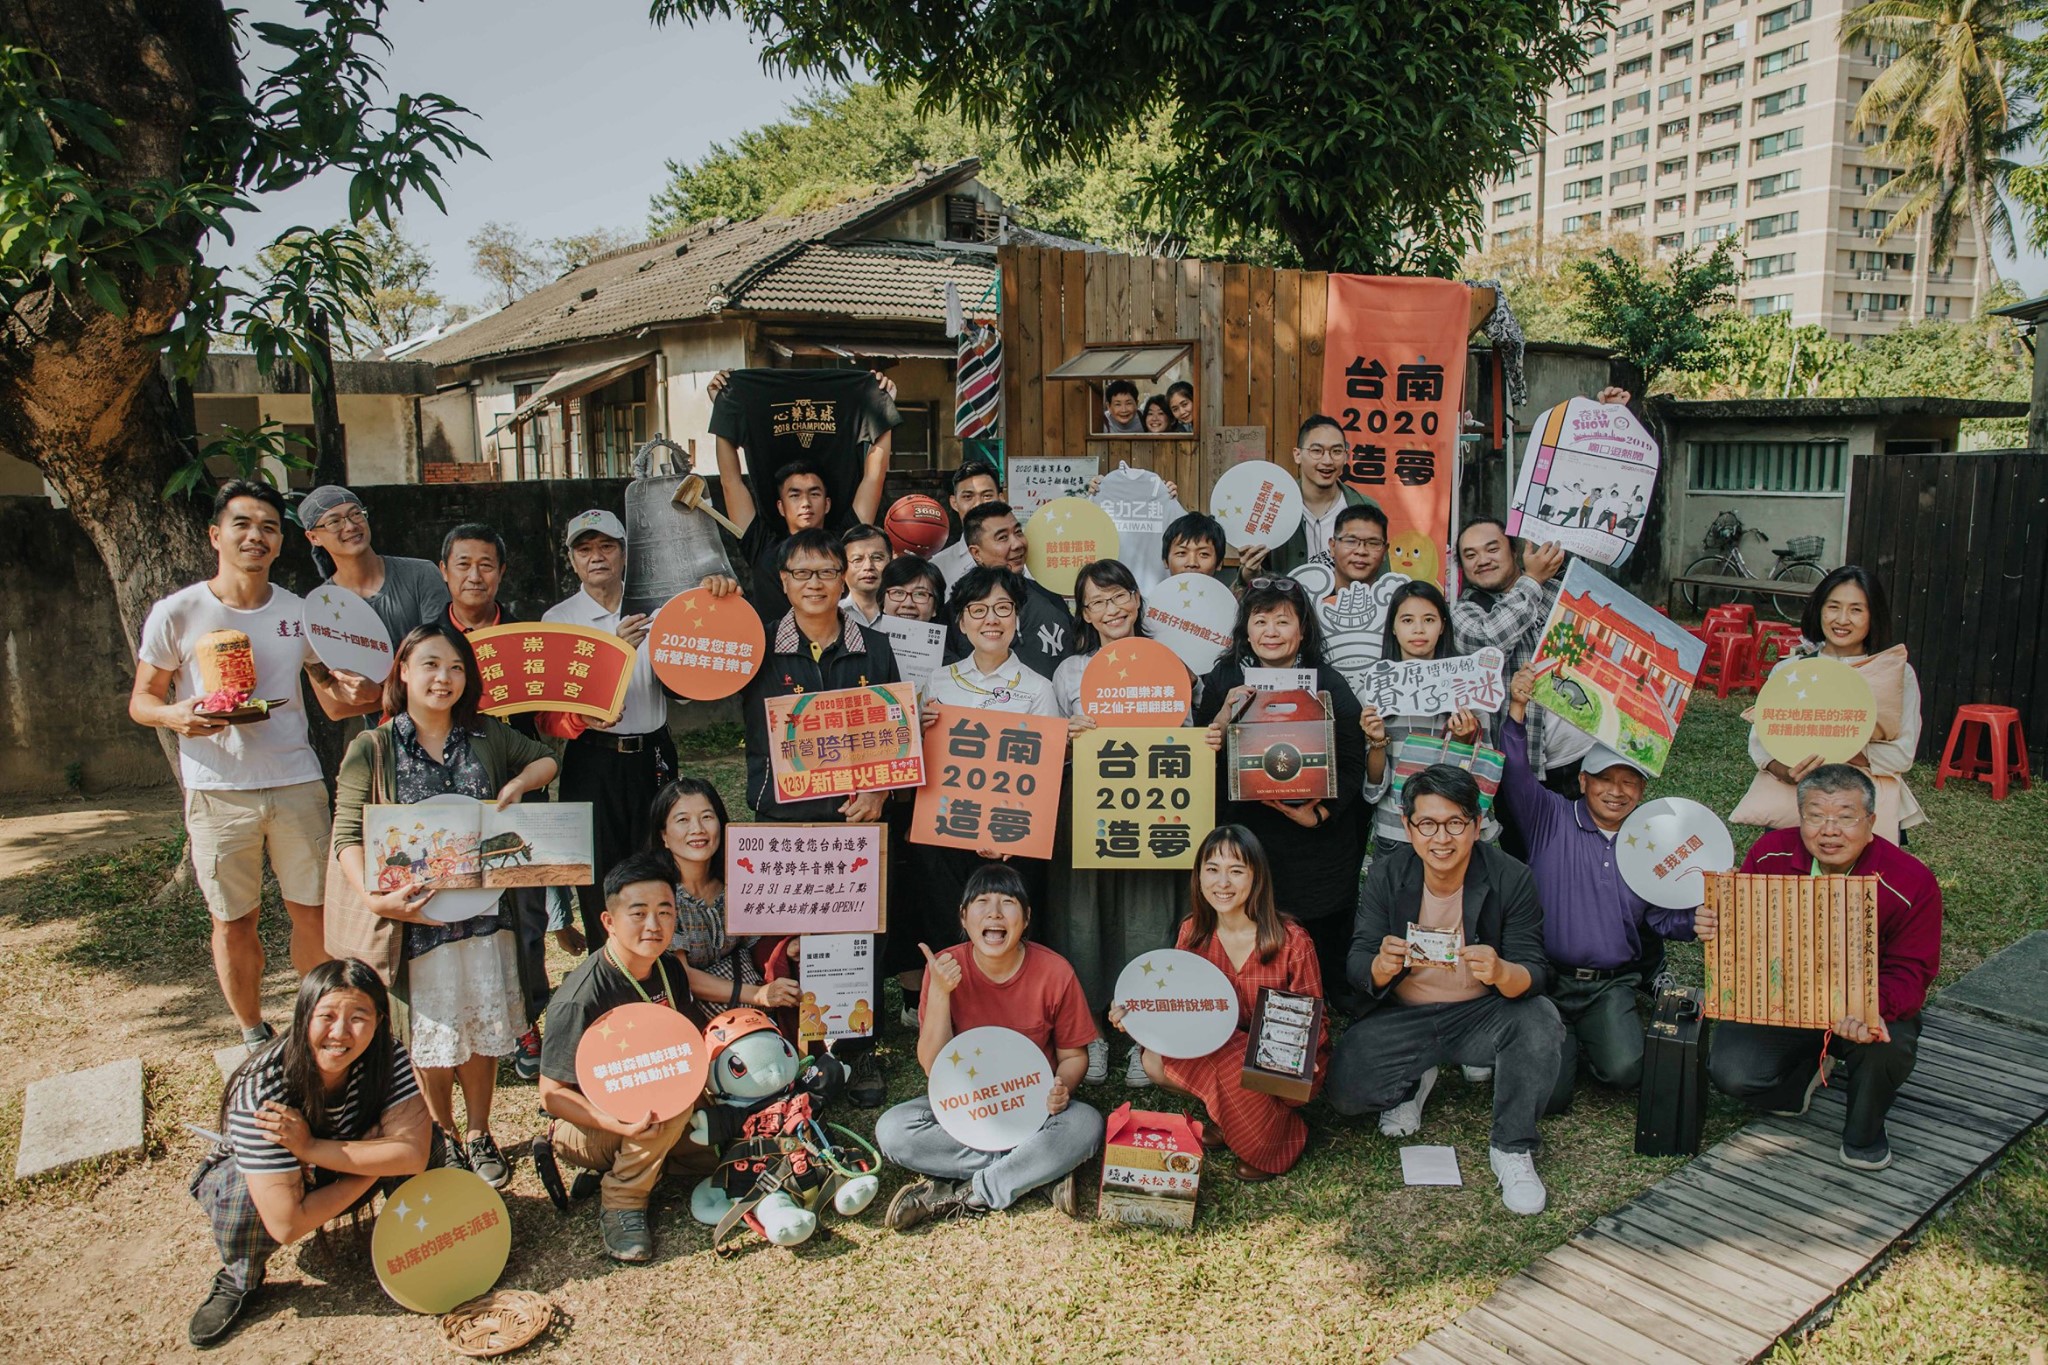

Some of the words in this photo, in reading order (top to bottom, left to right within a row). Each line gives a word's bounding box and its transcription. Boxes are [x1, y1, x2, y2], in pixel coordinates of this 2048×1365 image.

[1345, 356, 1444, 401] 台南
[773, 422, 790, 433] 2018
[792, 421, 836, 432] CHAMPIONS
[1342, 408, 1439, 436] 2020
[1572, 419, 1610, 430] SHOW
[1626, 436, 1653, 451] 2019
[1342, 444, 1435, 486] 造夢
[914, 507, 941, 517] 3600
[1259, 490, 1286, 534] 演出計畫
[1118, 522, 1153, 531] TAIWAN
[1046, 541, 1096, 554] 敲鐘擂鼓
[1046, 555, 1096, 569] 跨年祈福
[311, 623, 389, 653] 府城二十四節氣巷
[661, 633, 753, 657] 2020愛您愛您
[475, 643, 509, 702] 集福宮
[523, 637, 545, 696] 崇福宮
[563, 639, 596, 699] 聚福宮
[654, 648, 754, 675] 新營跨年音樂會
[815, 694, 872, 711] 2020愛您愛您
[1096, 686, 1175, 699] 2020國樂演奏
[803, 705, 887, 732] 台南造夢
[1762, 708, 1867, 722] 與在地居民的深夜
[948, 718, 1043, 766] 台南
[1767, 723, 1859, 737] 廣播劇集體創作
[781, 726, 911, 766] 新營跨年音樂會
[1097, 737, 1191, 779] 台南
[811, 763, 919, 793] 新營火車站
[942, 765, 1036, 796] 2020
[1096, 787, 1191, 810] 2020
[934, 798, 1033, 843] 造夢
[738, 838, 764, 851] 2020
[768, 837, 868, 853] 愛您愛您台南造夢
[1095, 816, 1191, 859] 造夢
[760, 861, 848, 876] 新營跨年音樂會
[744, 901, 831, 914] 新營火車站前廣場
[832, 901, 865, 913] OPEN!!
[1125, 998, 1230, 1012] 來吃圓餅說鄉事
[604, 1060, 691, 1093] 教育推動計畫
[939, 1093, 970, 1111] YOU
[972, 1084, 1000, 1102] ARE
[1001, 1072, 1041, 1094] WHAT
[968, 1103, 998, 1121] YOU
[1001, 1095, 1025, 1112] EAT
[386, 1208, 500, 1276] 缺席的跨年派對
